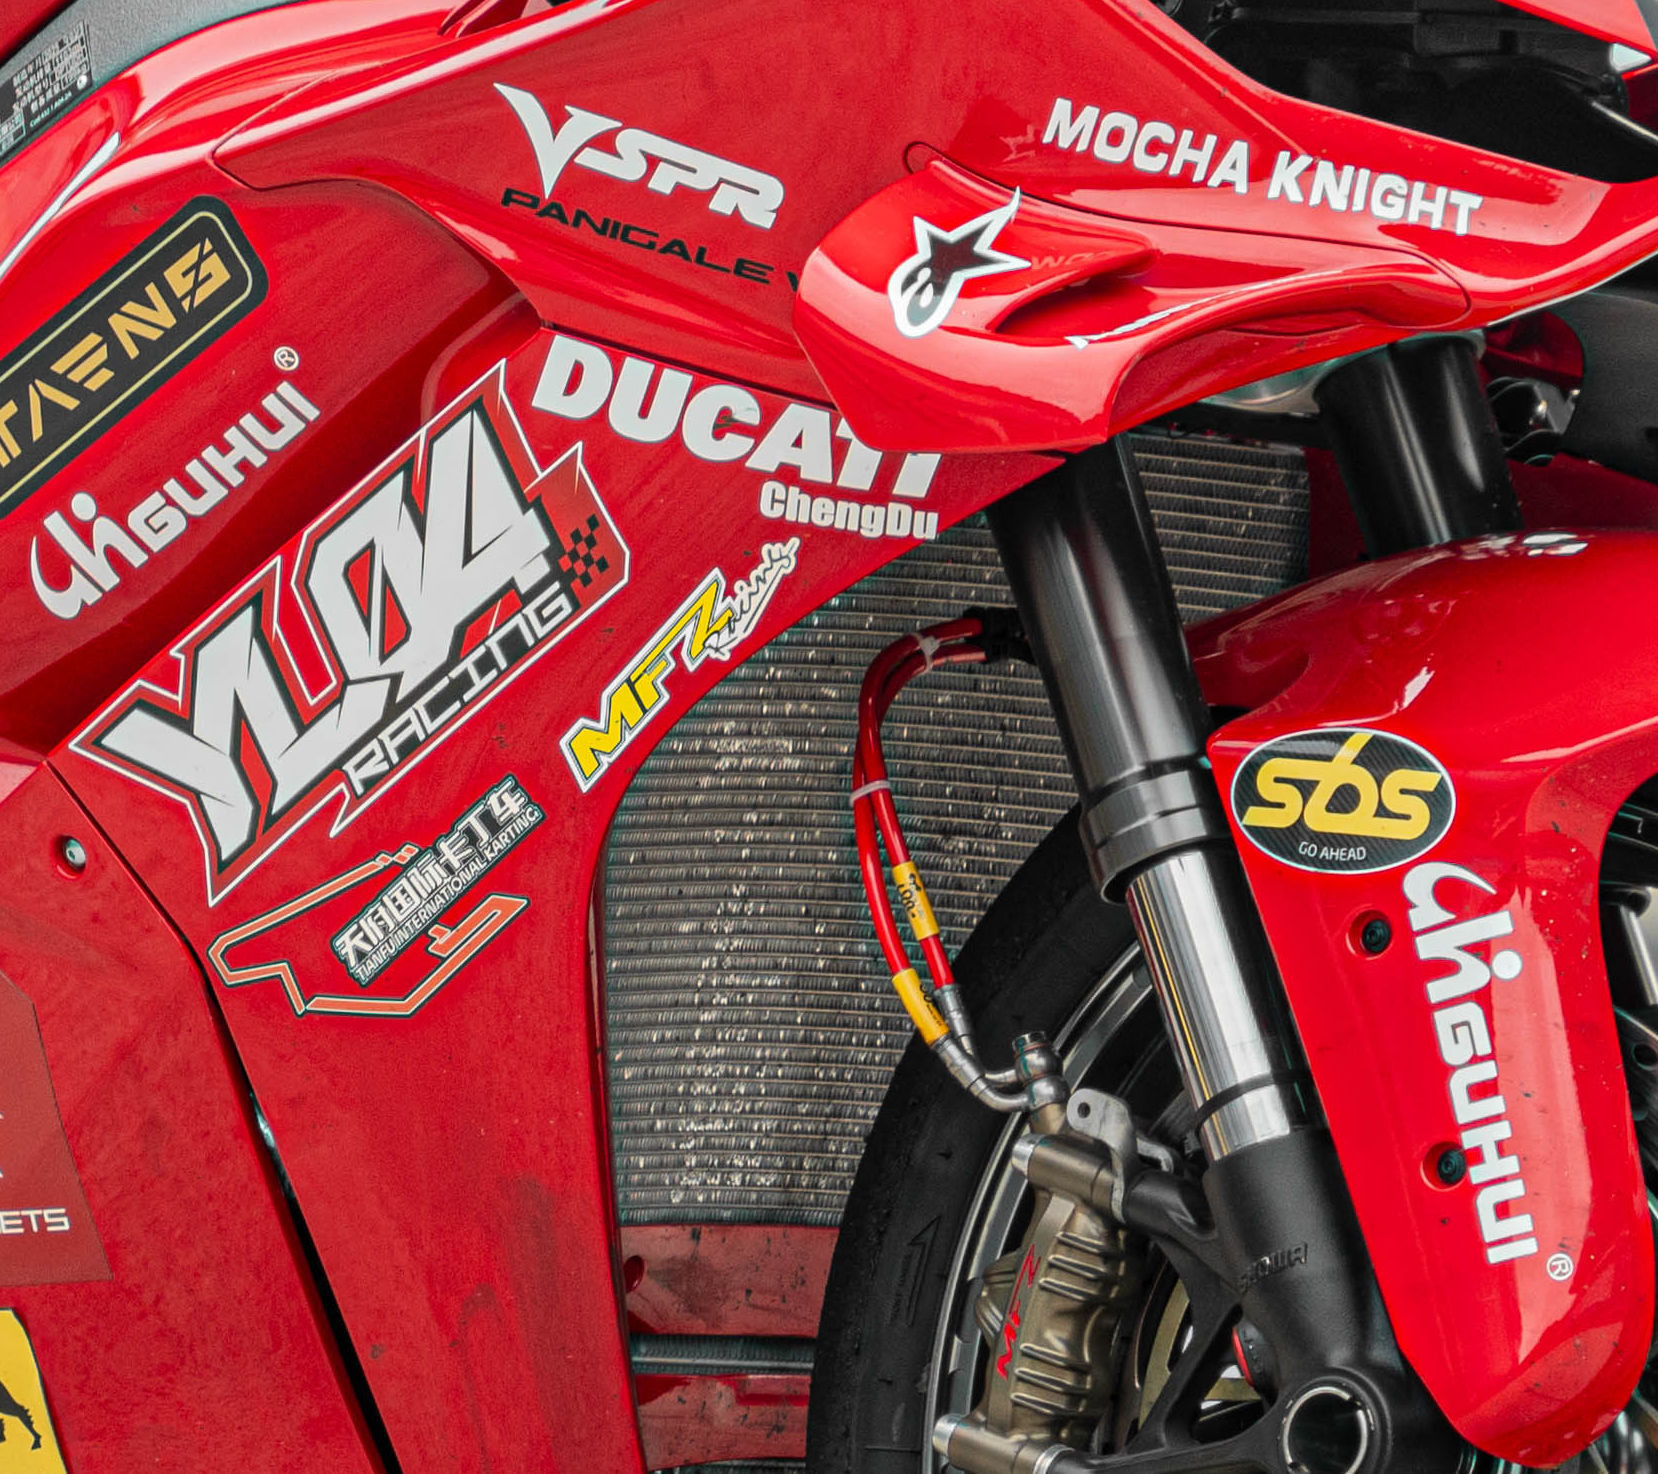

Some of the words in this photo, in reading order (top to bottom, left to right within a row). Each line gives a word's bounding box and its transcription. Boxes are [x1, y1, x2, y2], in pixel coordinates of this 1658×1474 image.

[500, 187, 775, 285] PANIGALE
[1042, 98, 1249, 194] MOCHA
[1268, 151, 1483, 236] KNIGHT
[760, 480, 939, 540] ChengDu
[342, 582, 573, 797] RACING
[568, 578, 733, 779] MFZ
[334, 779, 527, 968] 天府国际卡丁车
[356, 940, 397, 982] TIANFU
[395, 856, 486, 950] INTERNATIONAL
[483, 806, 540, 862] KARTING
[1298, 841, 1318, 857] GO
[1319, 846, 1367, 861] AHEAD
